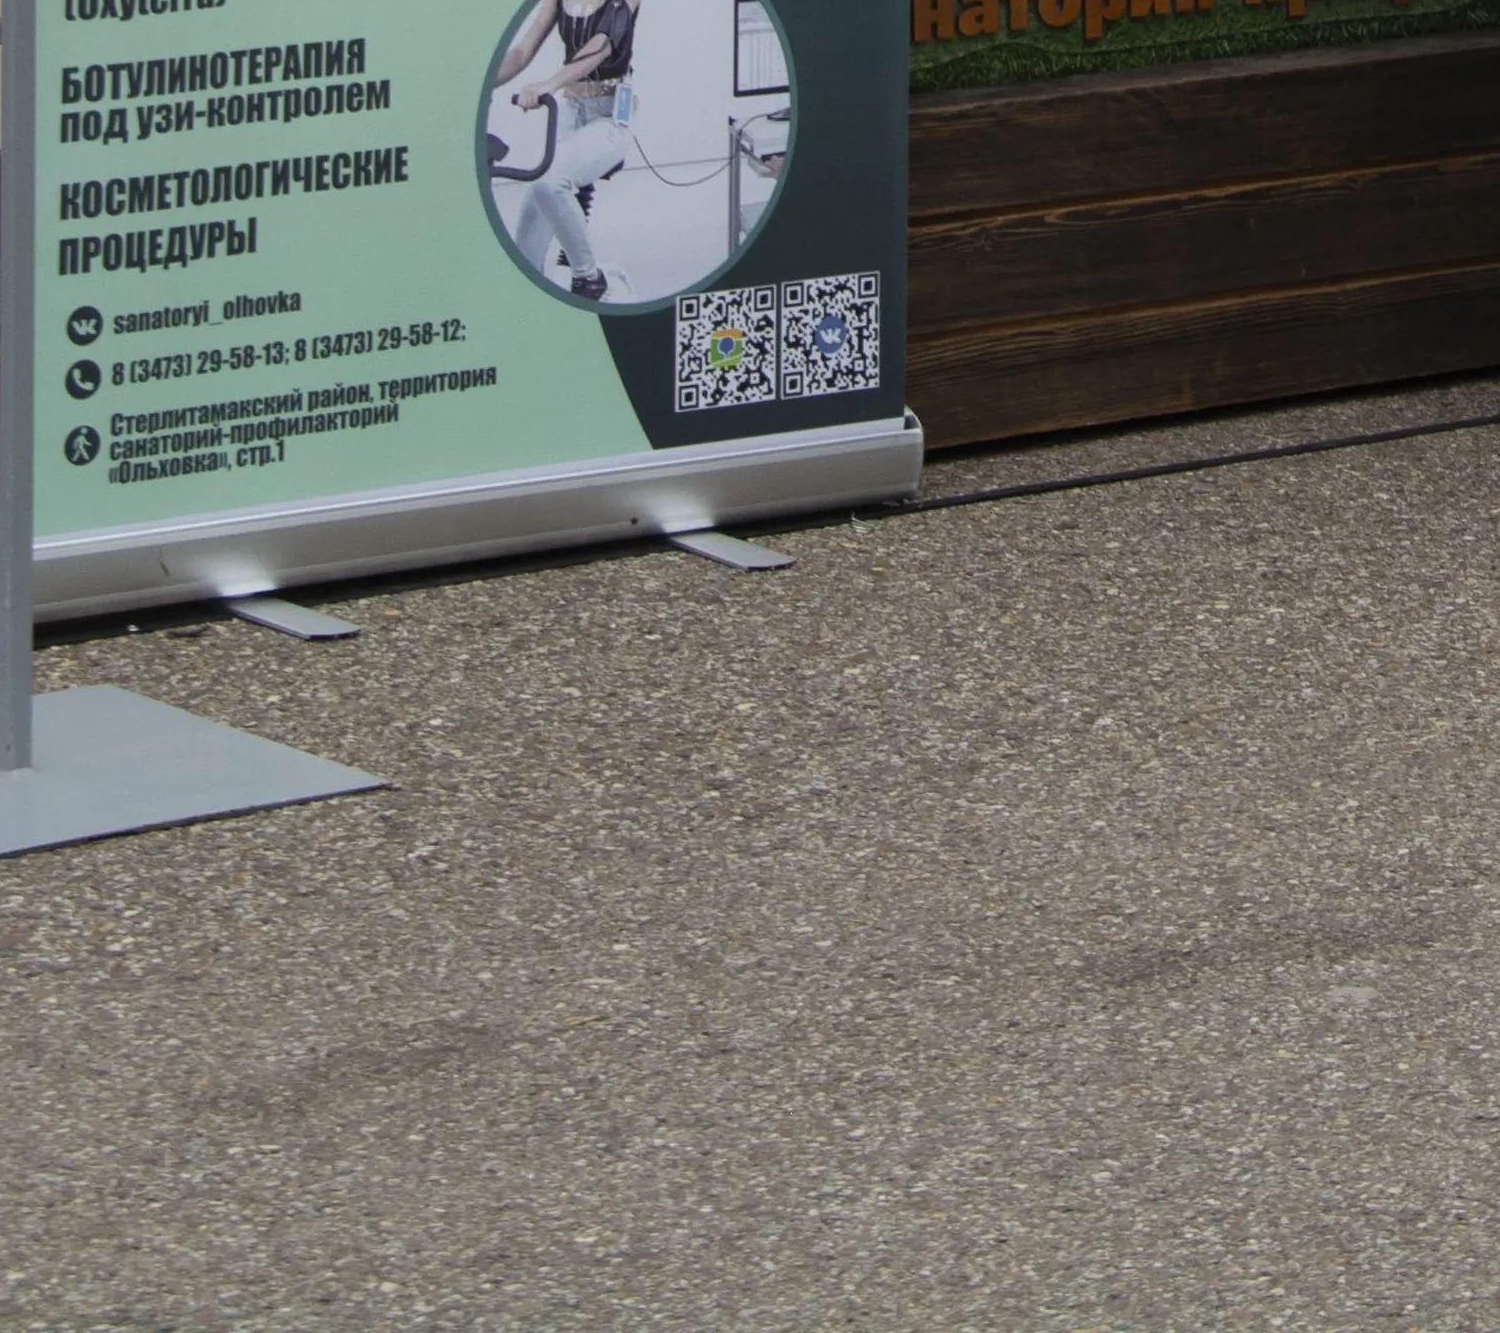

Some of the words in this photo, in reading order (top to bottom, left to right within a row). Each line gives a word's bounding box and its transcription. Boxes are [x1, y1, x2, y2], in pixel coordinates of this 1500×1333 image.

[61, 38, 366, 105] БОТУЛИНОТЕРАПИЯ
[60, 101, 130, 148] под
[137, 80, 391, 135] узи-контролем
[59, 145, 409, 222] КОСМЕТОЛОГИЧЕСКИЕ
[58, 217, 258, 277] ПРОЦЕДУРЫ
[113, 291, 302, 335] sanatoryi_olhovka
[111, 363, 126, 386] 8
[129, 353, 193, 383] (3473)
[197, 342, 291, 375] 29-58-13;
[294, 339, 307, 362] 8
[311, 330, 374, 360] (3473)
[377, 318, 468, 351] 29-58-12;
[109, 399, 400, 462] санаторий-профилакторий
[110, 389, 303, 437] Стерлитамакский
[307, 383, 375, 411] район,
[378, 366, 498, 400] территория
[108, 449, 232, 485] «Ольховка»,
[236, 440, 286, 470] стр.1
